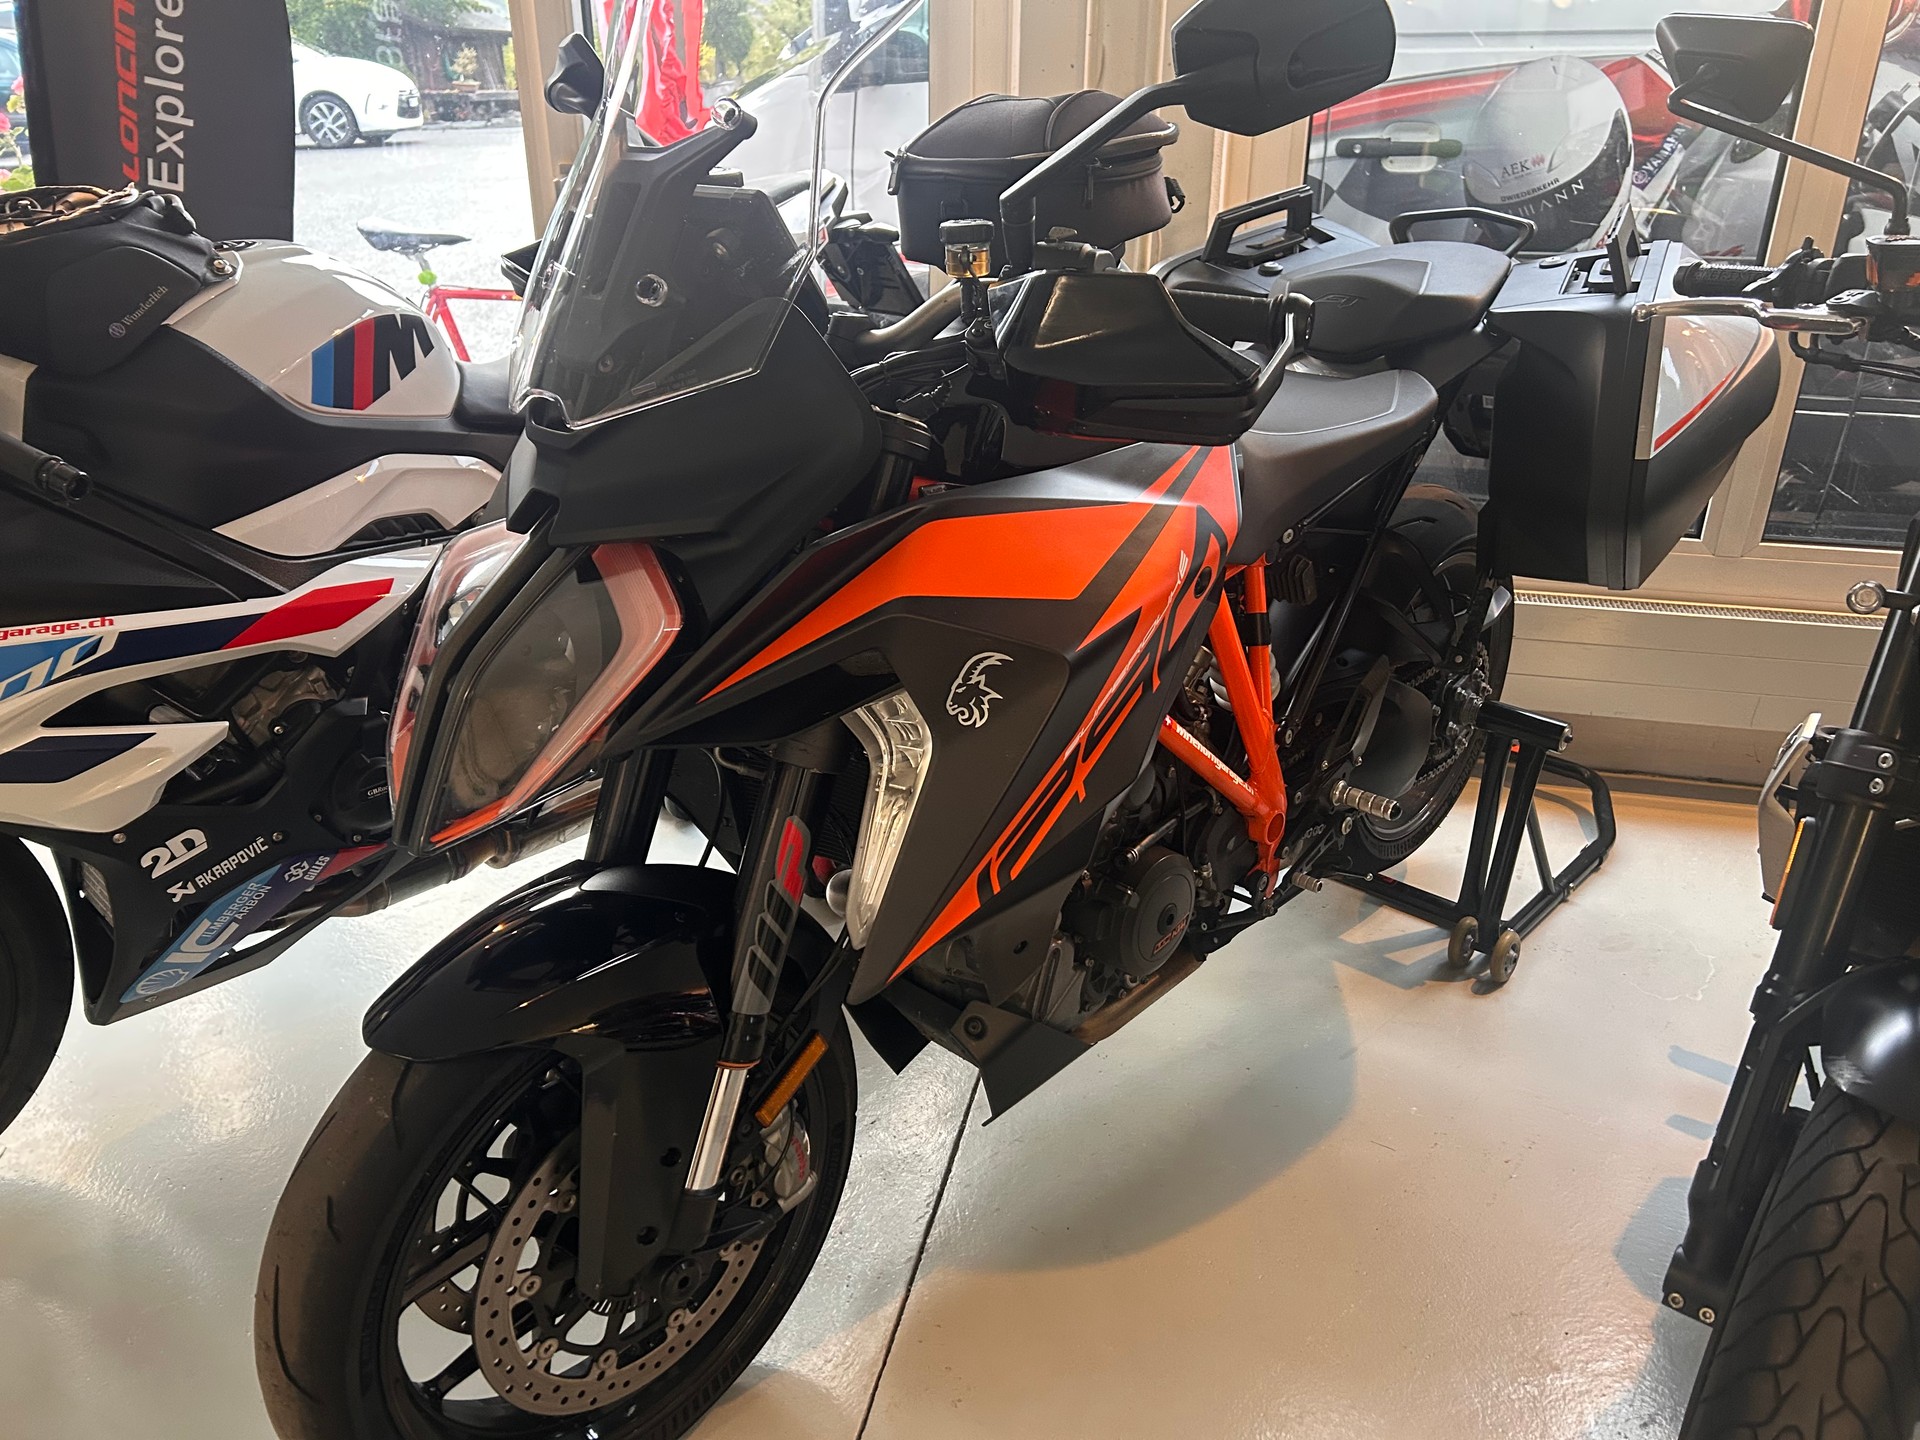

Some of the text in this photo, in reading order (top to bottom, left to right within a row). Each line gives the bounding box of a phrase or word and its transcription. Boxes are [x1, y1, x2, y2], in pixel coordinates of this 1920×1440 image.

[1501, 161, 1531, 179] AEK
[1641, 125, 1687, 172] YAMAHA
[121, 285, 168, 326] Wunderlich
[140, 828, 208, 880] 2D
[303, 855, 330, 882] GILLES
[202, 881, 261, 939] ILMBERGER
